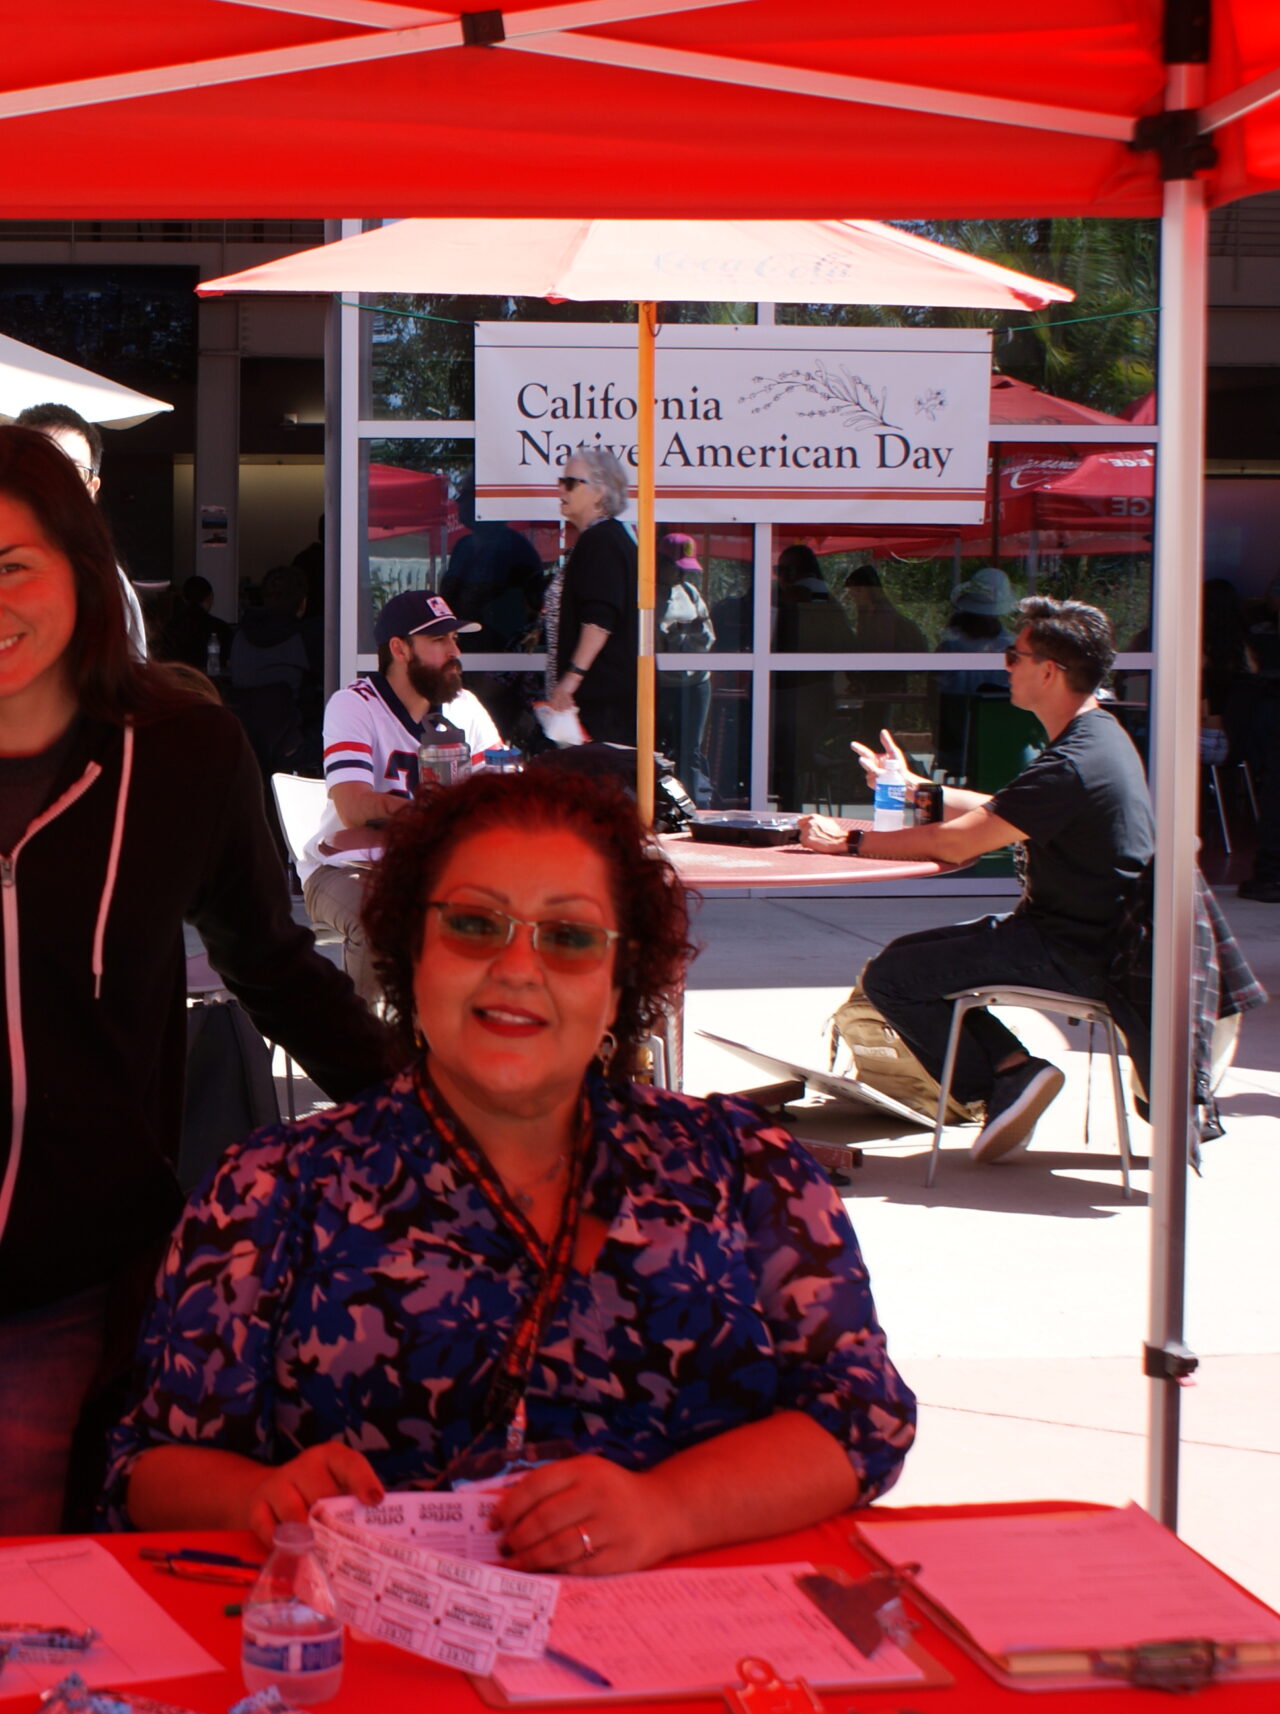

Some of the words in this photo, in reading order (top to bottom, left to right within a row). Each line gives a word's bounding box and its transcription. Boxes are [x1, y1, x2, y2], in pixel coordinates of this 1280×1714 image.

[517, 382, 723, 421] Califonia
[660, 432, 859, 469] American
[875, 433, 954, 478] Day
